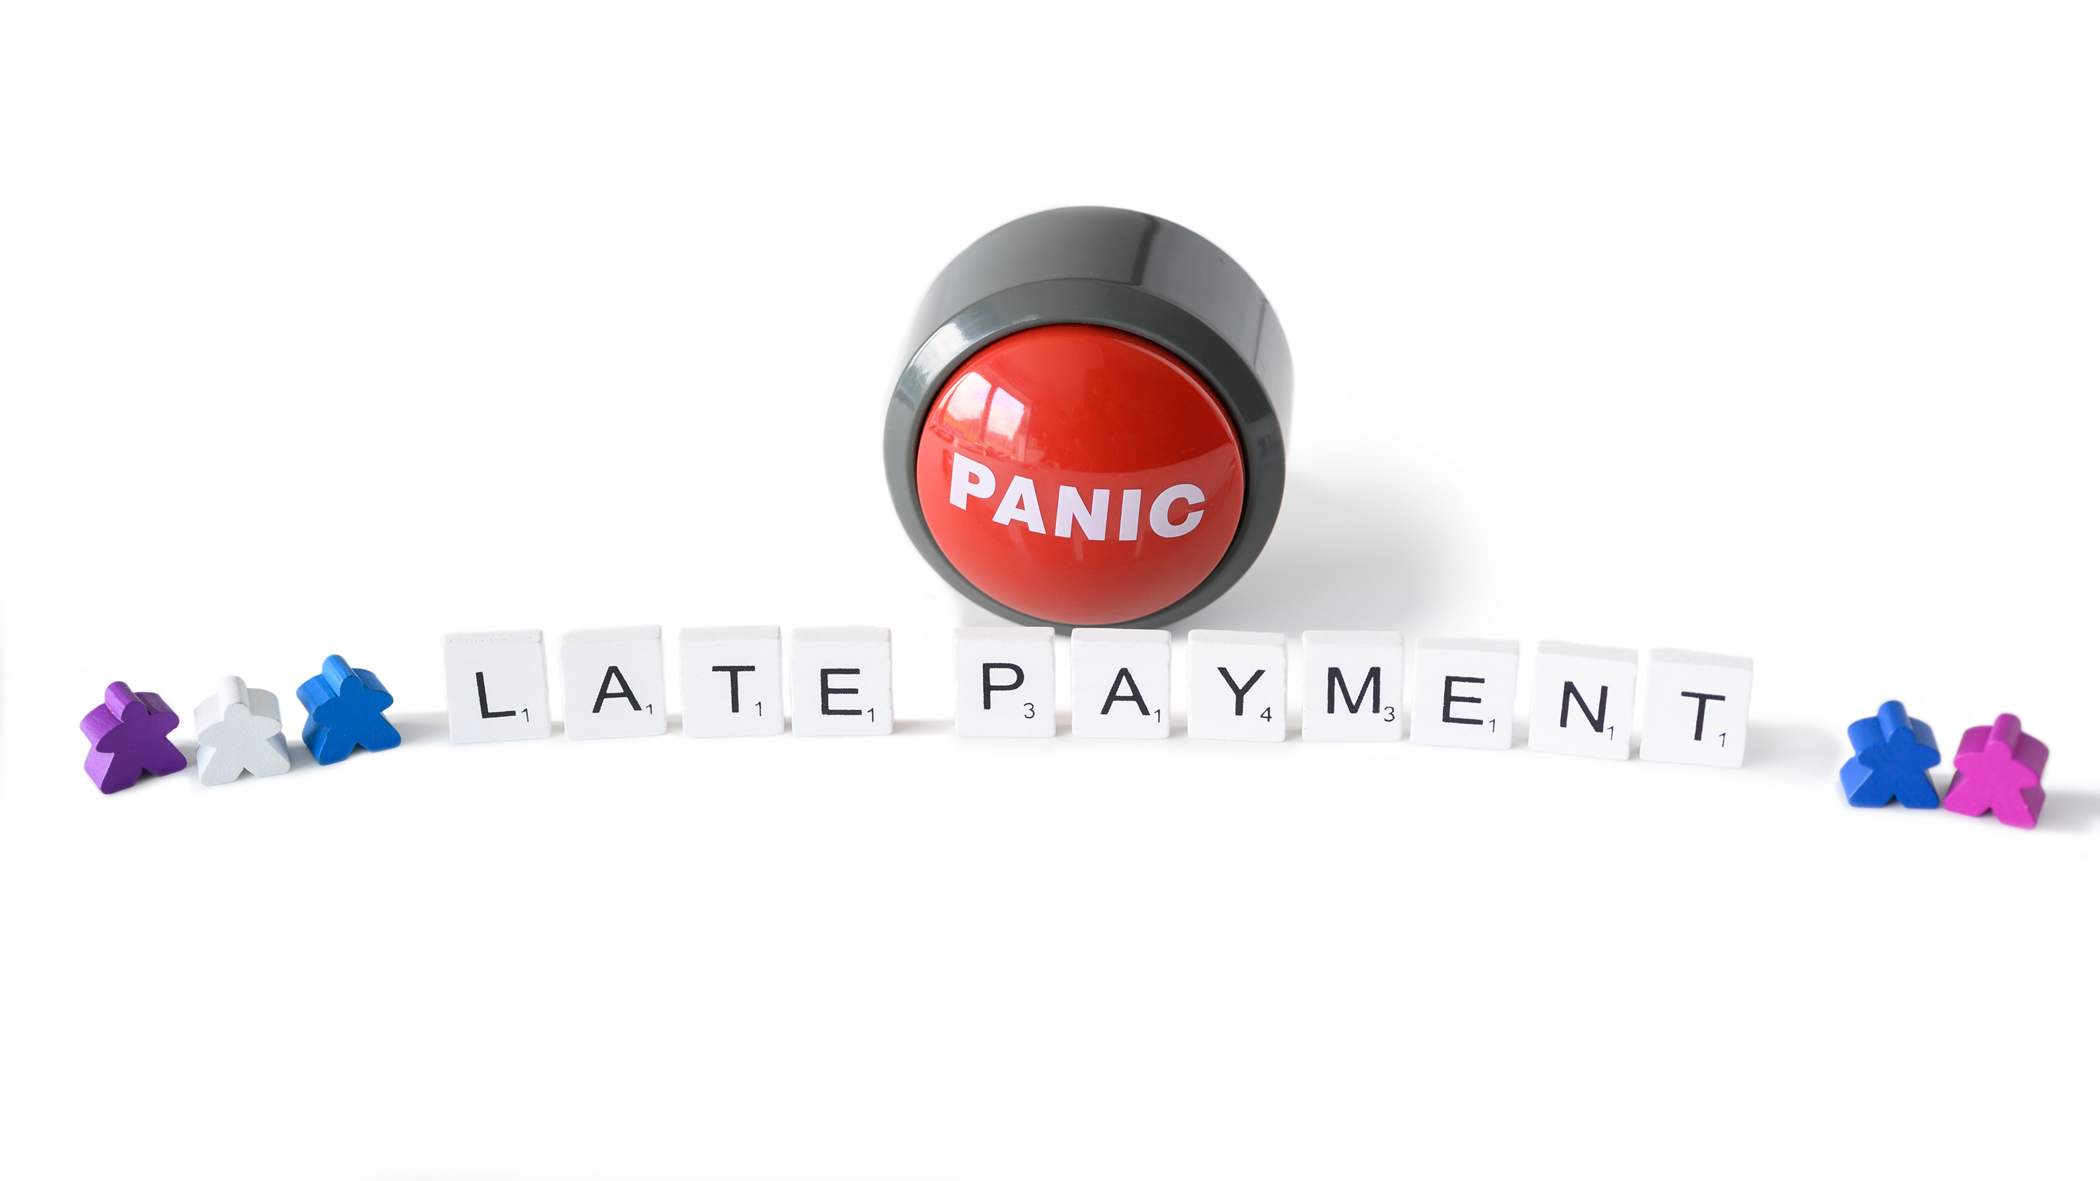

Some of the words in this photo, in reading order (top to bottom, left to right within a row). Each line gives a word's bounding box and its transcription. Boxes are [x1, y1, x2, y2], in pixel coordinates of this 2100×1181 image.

[949, 452, 1206, 542] PANIC
[474, 664, 864, 721] LATE
[981, 661, 1727, 743] PAYMENT
[645, 703, 653, 715] 1
[754, 701, 762, 717] 1
[520, 708, 530, 723] 1
[867, 707, 875, 723] 1
[1023, 702, 1036, 719] 3
[1154, 709, 1162, 723] 1
[1259, 706, 1273, 723] 4
[1383, 706, 1396, 723] 3
[1488, 718, 1497, 733] 1
[1607, 725, 1614, 741] 1
[1718, 732, 1727, 748] 1
